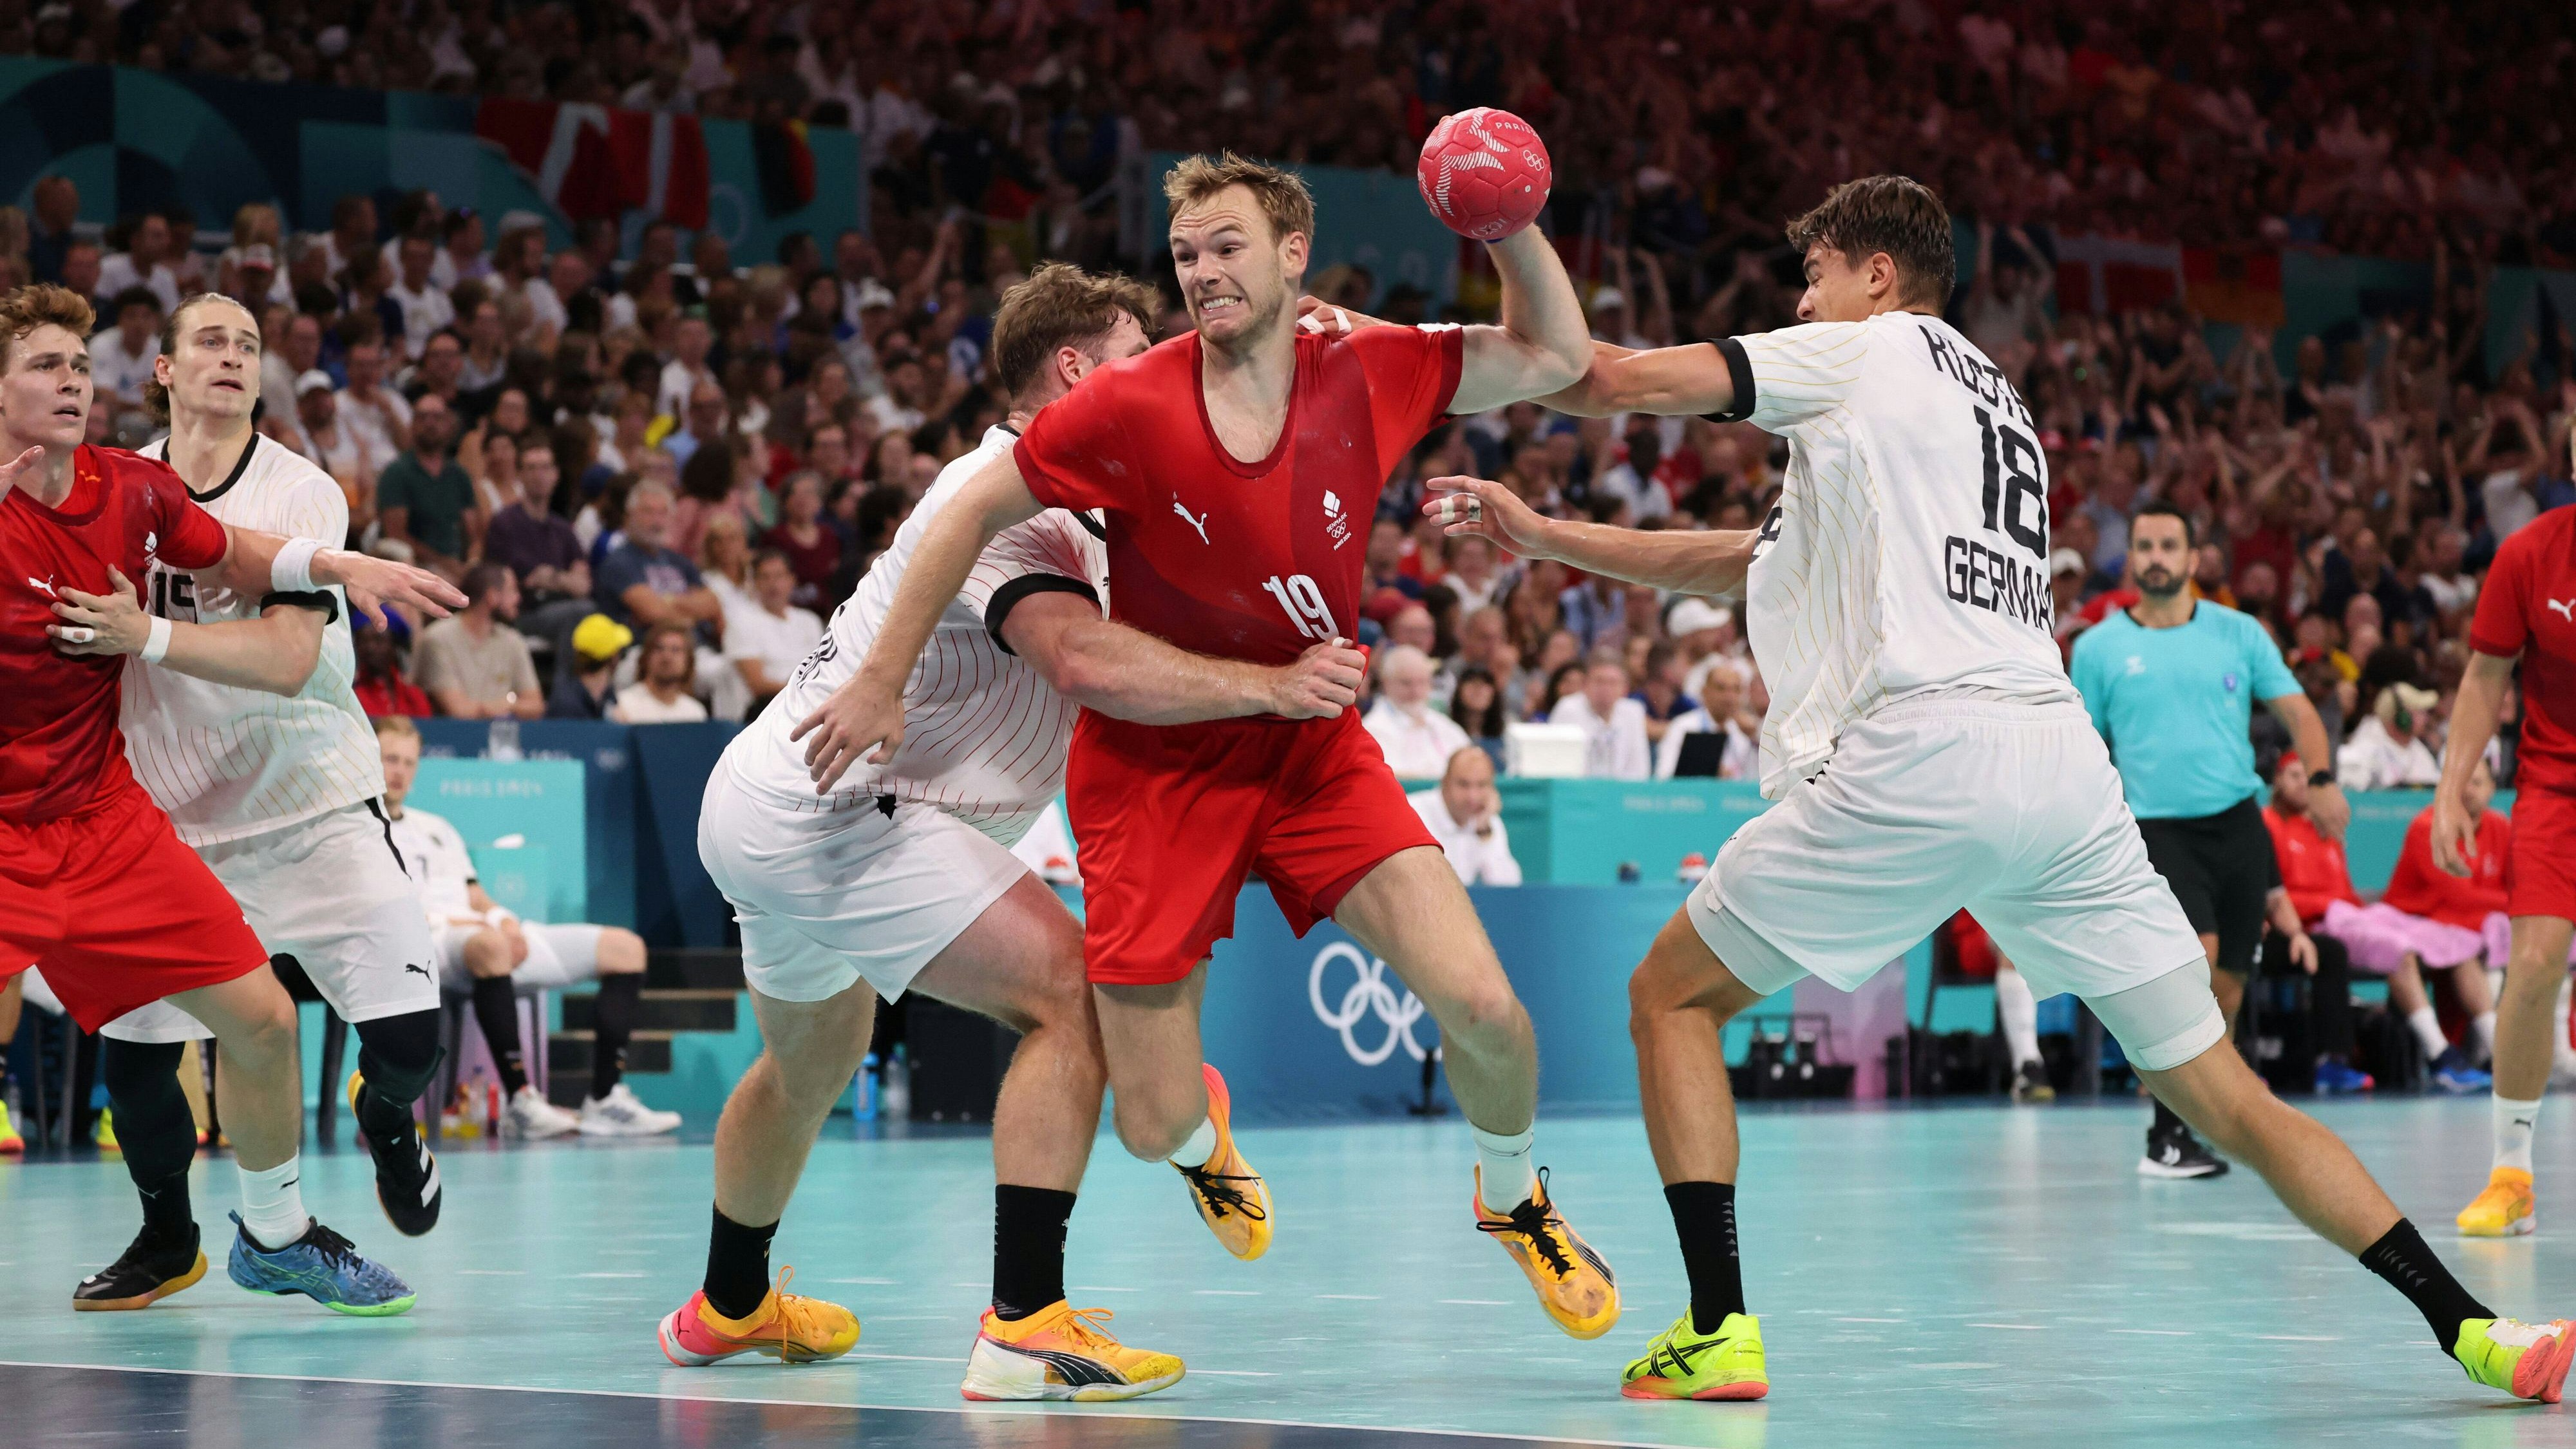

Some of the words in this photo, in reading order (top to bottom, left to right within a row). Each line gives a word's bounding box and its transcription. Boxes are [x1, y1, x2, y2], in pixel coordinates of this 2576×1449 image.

[1974, 404, 2047, 560] 18
[1327, 511, 1348, 533] DENMARK
[1262, 574, 1340, 642] 19
